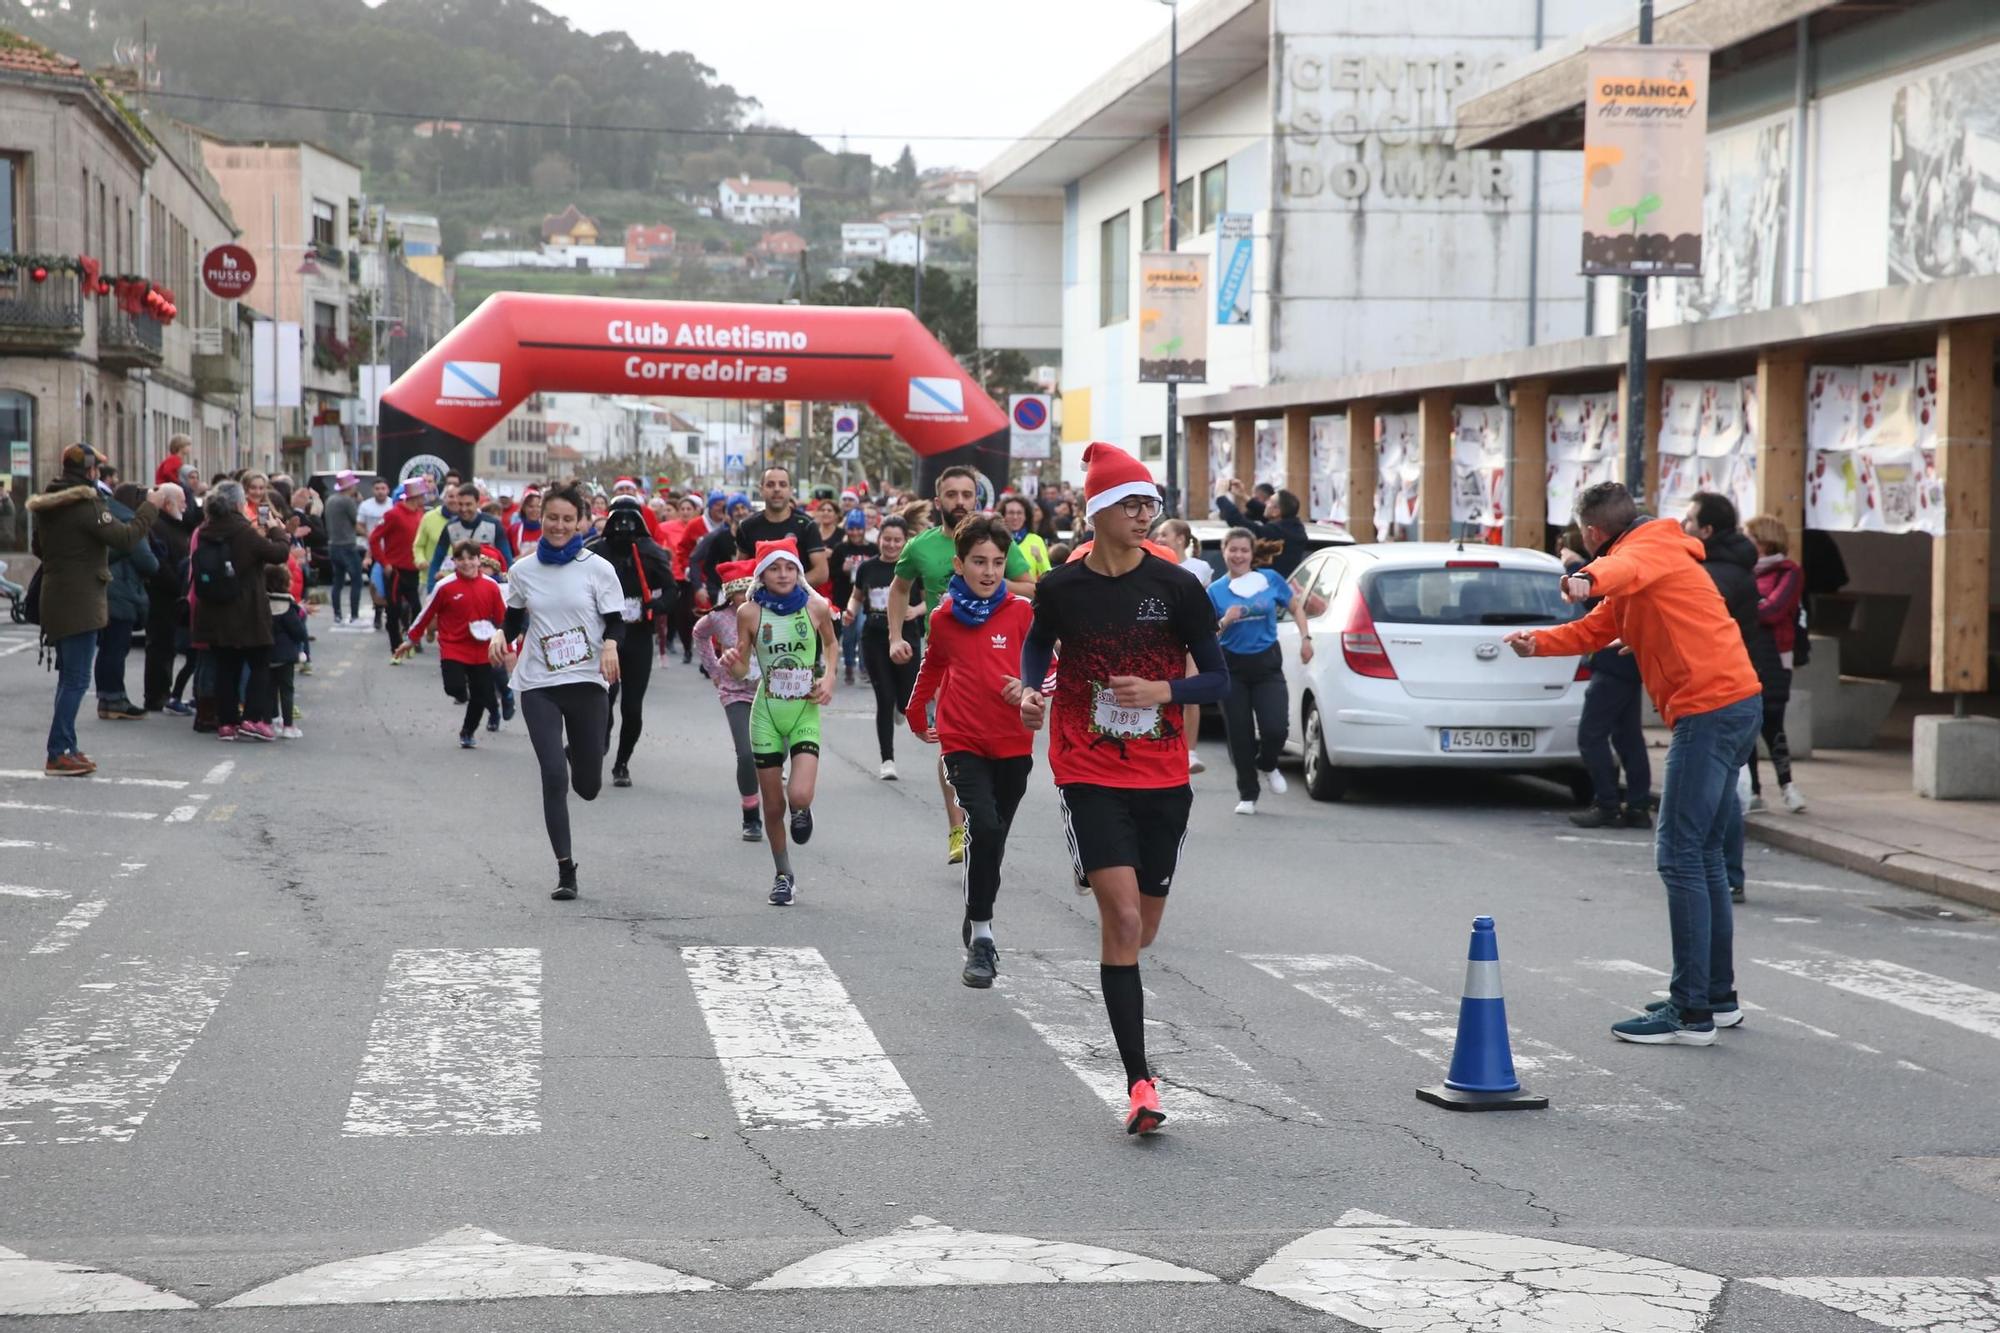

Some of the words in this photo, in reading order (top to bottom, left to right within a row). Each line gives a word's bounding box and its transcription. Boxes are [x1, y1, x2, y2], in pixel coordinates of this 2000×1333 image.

[1601, 79, 1690, 97] ORGÁNICA
[1625, 98, 1697, 118] marrón!
[1290, 108, 1455, 145] SOCI
[208, 269, 251, 282] MUSEO
[607, 319, 669, 346] Club
[674, 323, 808, 350] Atletismo
[625, 356, 788, 383] Corredoiras
[768, 641, 806, 655] IRIA
[1110, 710, 1140, 726] 139
[1453, 731, 1495, 747] 4540
[1499, 731, 1531, 748] GWD
